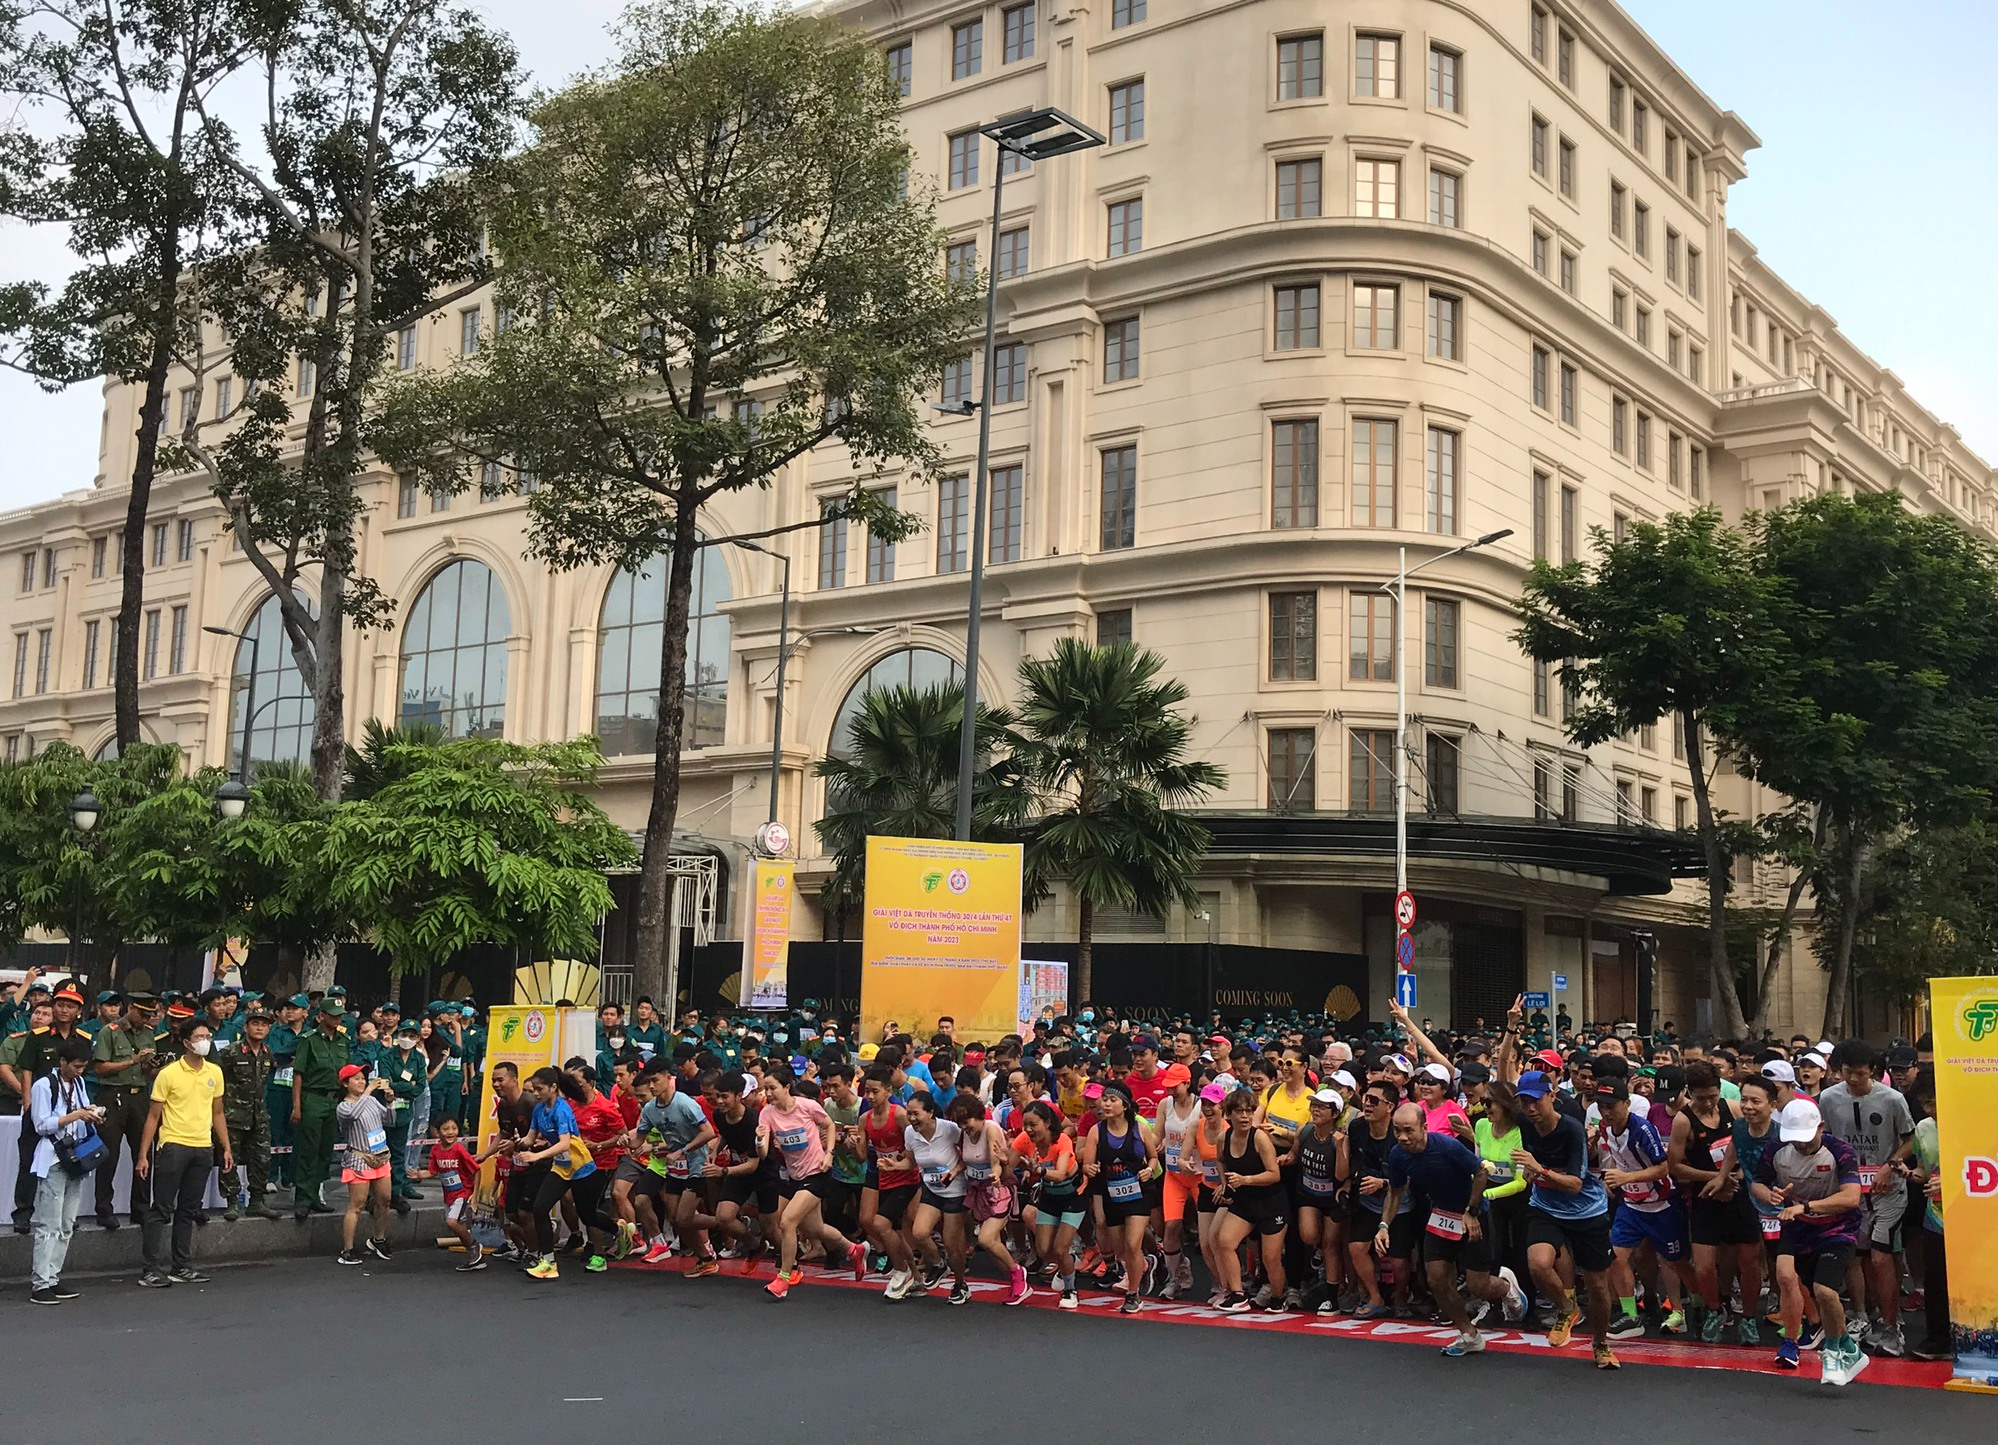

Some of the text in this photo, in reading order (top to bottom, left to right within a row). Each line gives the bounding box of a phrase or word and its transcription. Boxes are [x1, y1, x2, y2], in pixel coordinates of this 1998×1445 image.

[944, 936, 959, 944] 2023
[1215, 989, 1293, 1007] COMING SOON
[1659, 1079, 1669, 1089] M
[783, 1135, 801, 1145] 403
[1115, 1186, 1134, 1196] 302
[1438, 1217, 1455, 1230] 214
